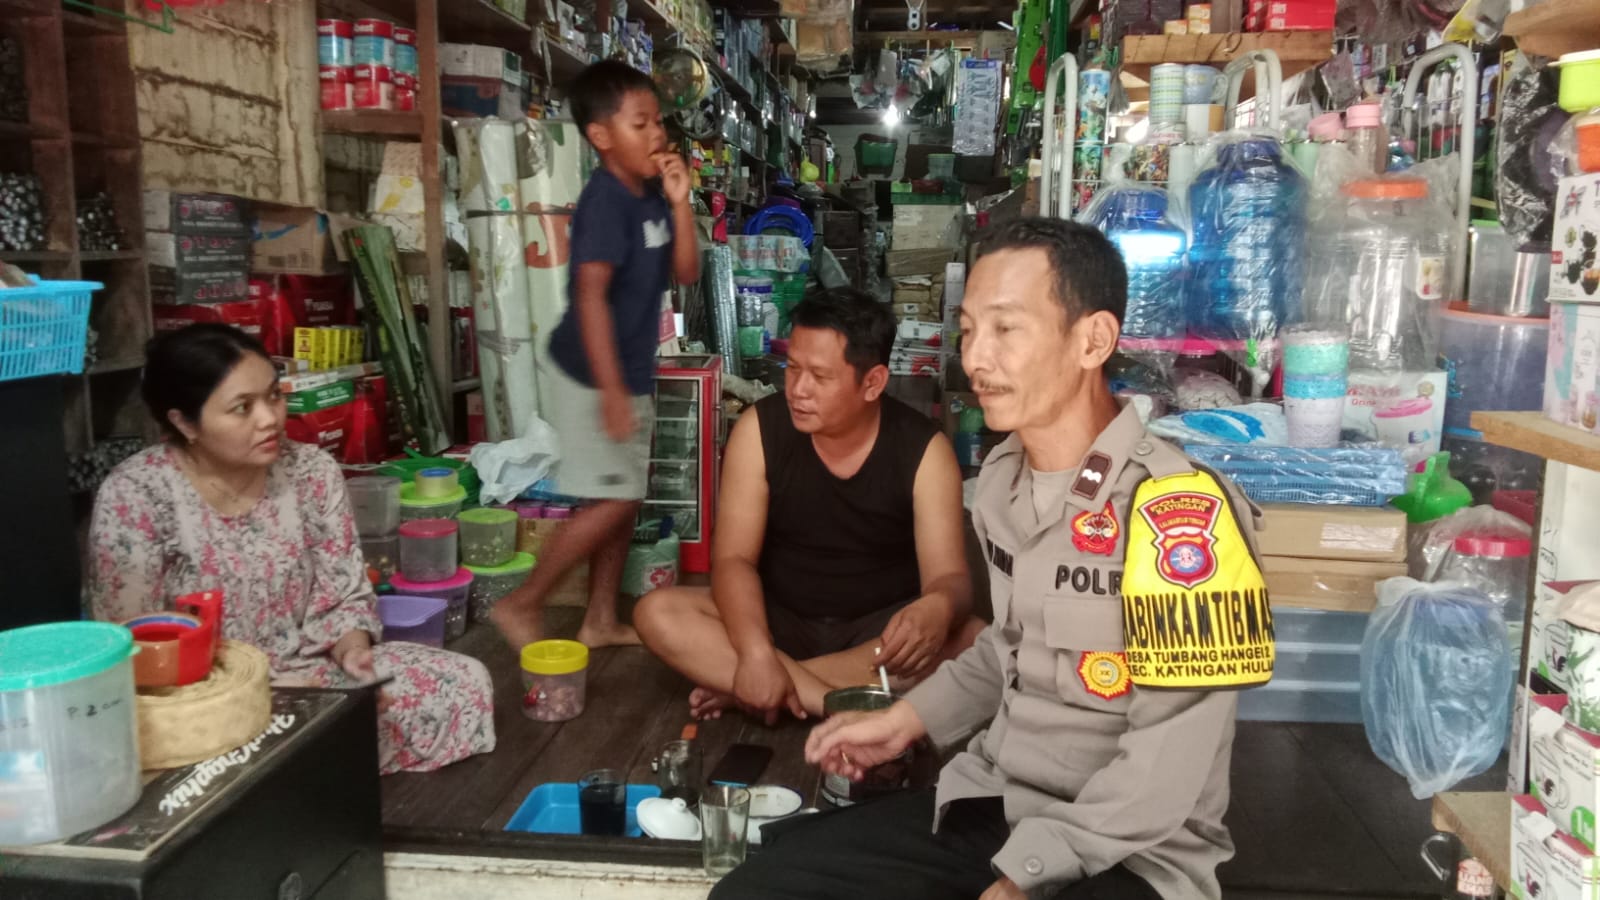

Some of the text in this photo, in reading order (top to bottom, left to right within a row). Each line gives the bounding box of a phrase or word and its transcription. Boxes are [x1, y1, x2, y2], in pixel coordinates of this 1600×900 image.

[1150, 497, 1211, 512] POLRES
[1155, 502, 1206, 515] KATINGAN
[1055, 564, 1122, 596] POLR
[1153, 649, 1218, 664] TUMBANG
[1155, 663, 1237, 678] KATINGAN
